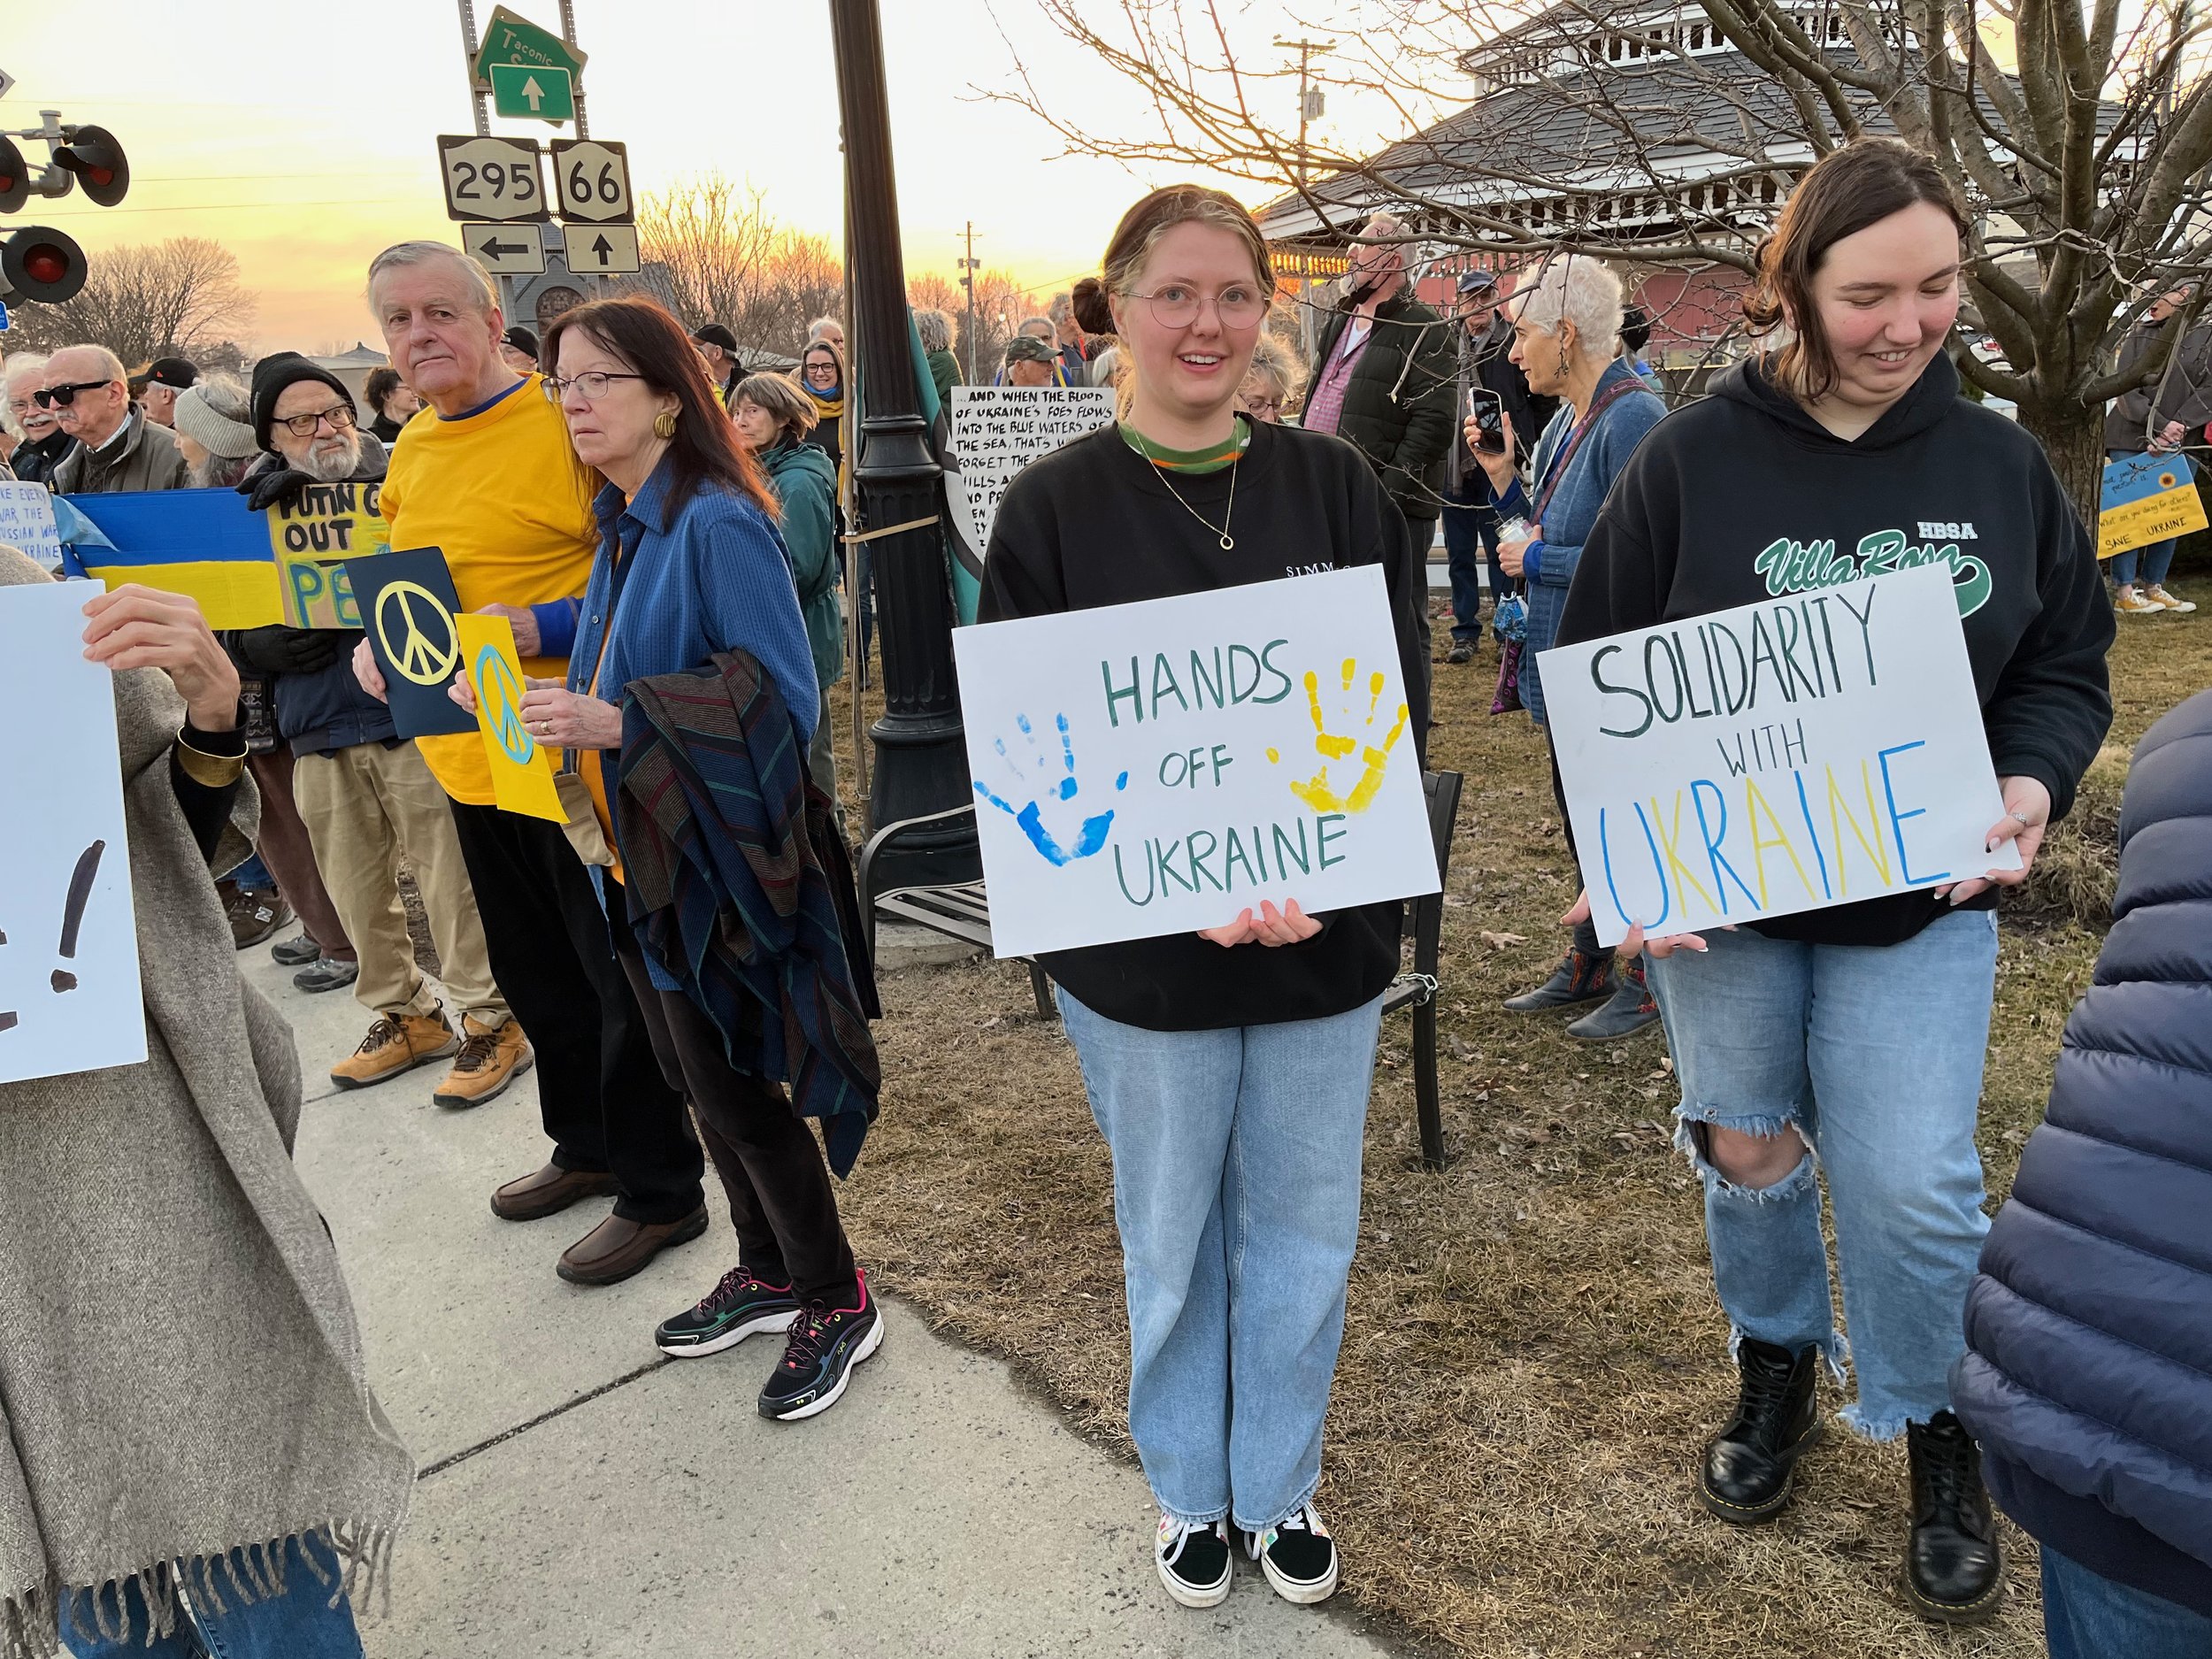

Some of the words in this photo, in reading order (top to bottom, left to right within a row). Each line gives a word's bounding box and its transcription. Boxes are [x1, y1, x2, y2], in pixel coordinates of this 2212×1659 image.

[503, 28, 553, 66] Taconic
[453, 162, 534, 201] 295
[570, 160, 619, 204] 66
[956, 408, 972, 419] OF
[977, 405, 1041, 419] UKRAINE'S
[1047, 406, 1072, 419] FOES
[1077, 406, 1113, 419] FLOWS
[1002, 391, 1038, 403] WHEN
[1041, 391, 1065, 403] THE
[1068, 391, 1103, 403] BLOOD
[956, 440, 979, 452] THE
[983, 438, 1012, 450] SEA,
[1015, 436, 1050, 449] THAT'S
[957, 422, 982, 435] INTO
[986, 422, 1006, 434] THE
[1010, 421, 1034, 434] BLUE
[1039, 421, 1083, 434] WATERS
[1088, 421, 1105, 431] OF
[958, 457, 1007, 469] FORGET
[1011, 455, 1030, 467] THE
[24, 508, 42, 519] THE
[279, 483, 356, 519] PUTIN
[0, 525, 35, 540] USSIAN
[285, 519, 353, 552] OUT
[1917, 521, 1978, 540] HBSA
[2105, 534, 2132, 550] SAVE
[2147, 517, 2187, 536] UKRAINE
[1755, 537, 1859, 596] Villa
[1591, 582, 1877, 738] SOLIDARITY
[1102, 639, 1293, 728] HANDS
[1159, 743, 1233, 789] OFF
[1717, 718, 1809, 778] WITH
[1600, 740, 1951, 930] UKRAINE
[1114, 813, 1347, 906] UKRAINE
